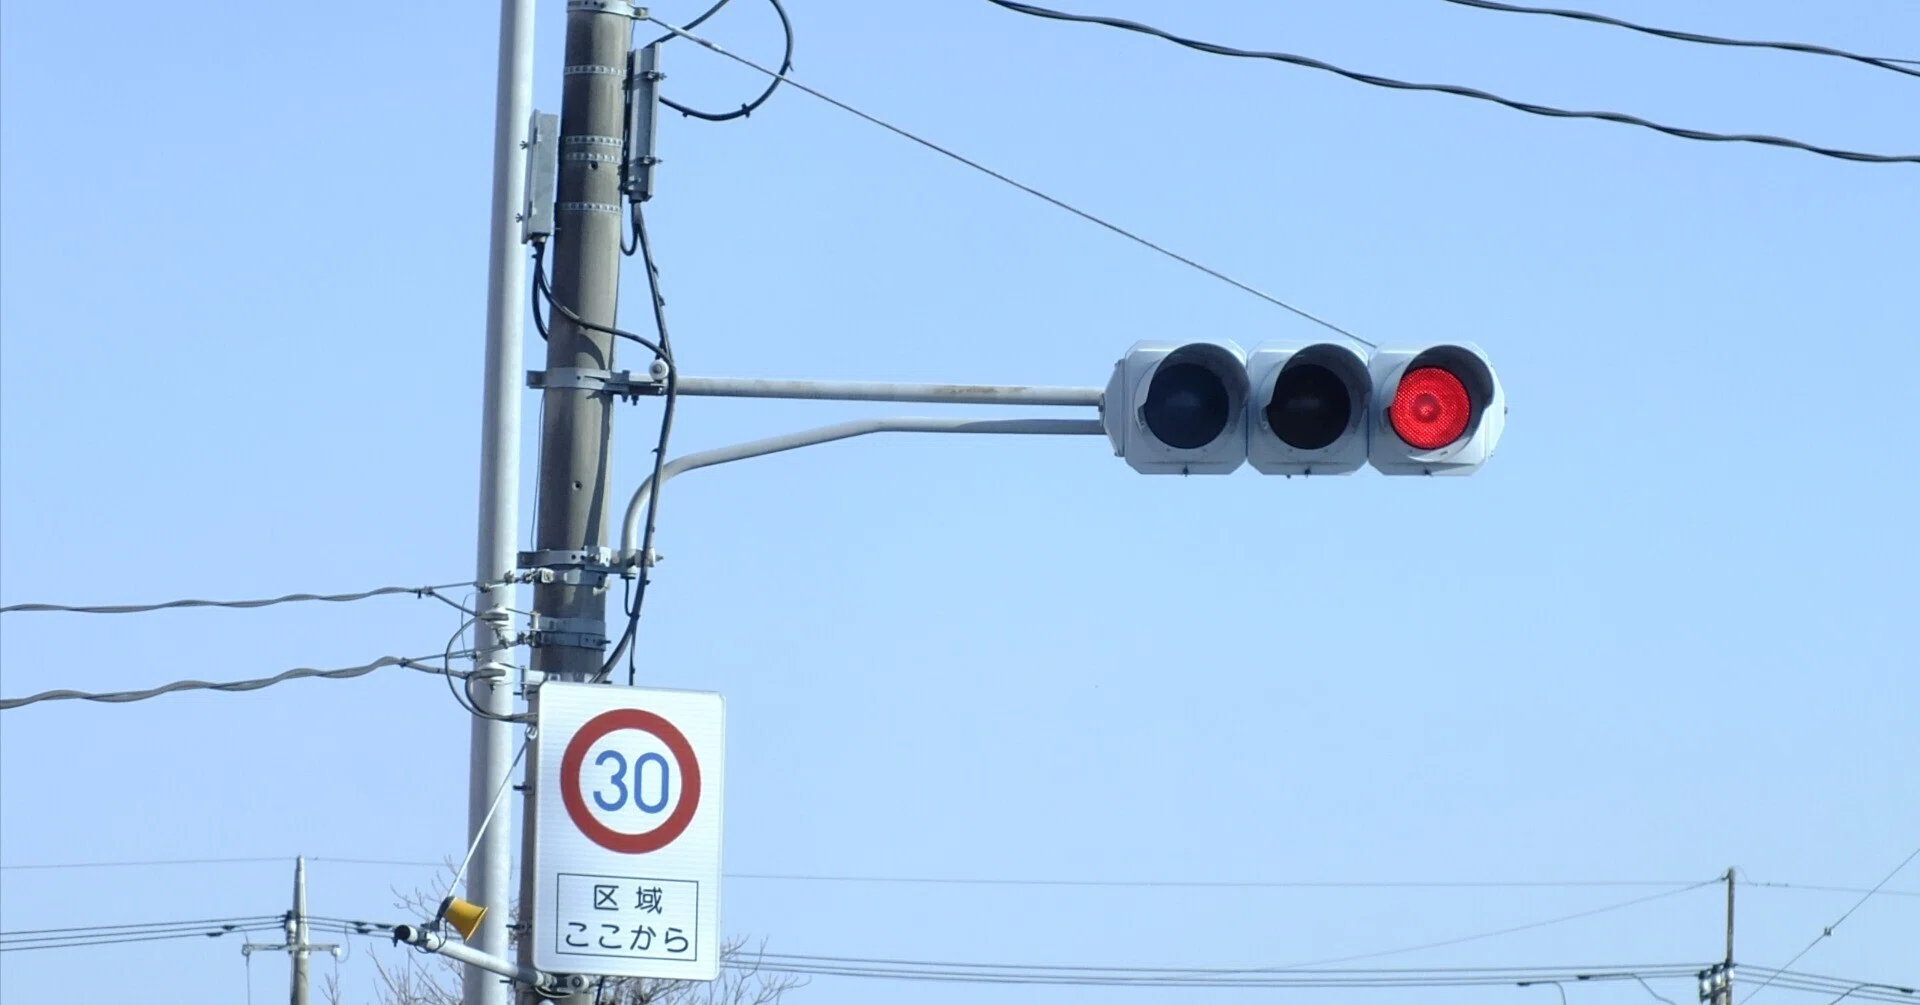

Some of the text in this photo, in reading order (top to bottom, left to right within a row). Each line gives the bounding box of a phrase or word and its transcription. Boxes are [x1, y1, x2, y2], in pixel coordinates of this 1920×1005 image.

[592, 749, 670, 814] 30
[593, 884, 663, 914] 区域
[565, 921, 689, 953] ここから
